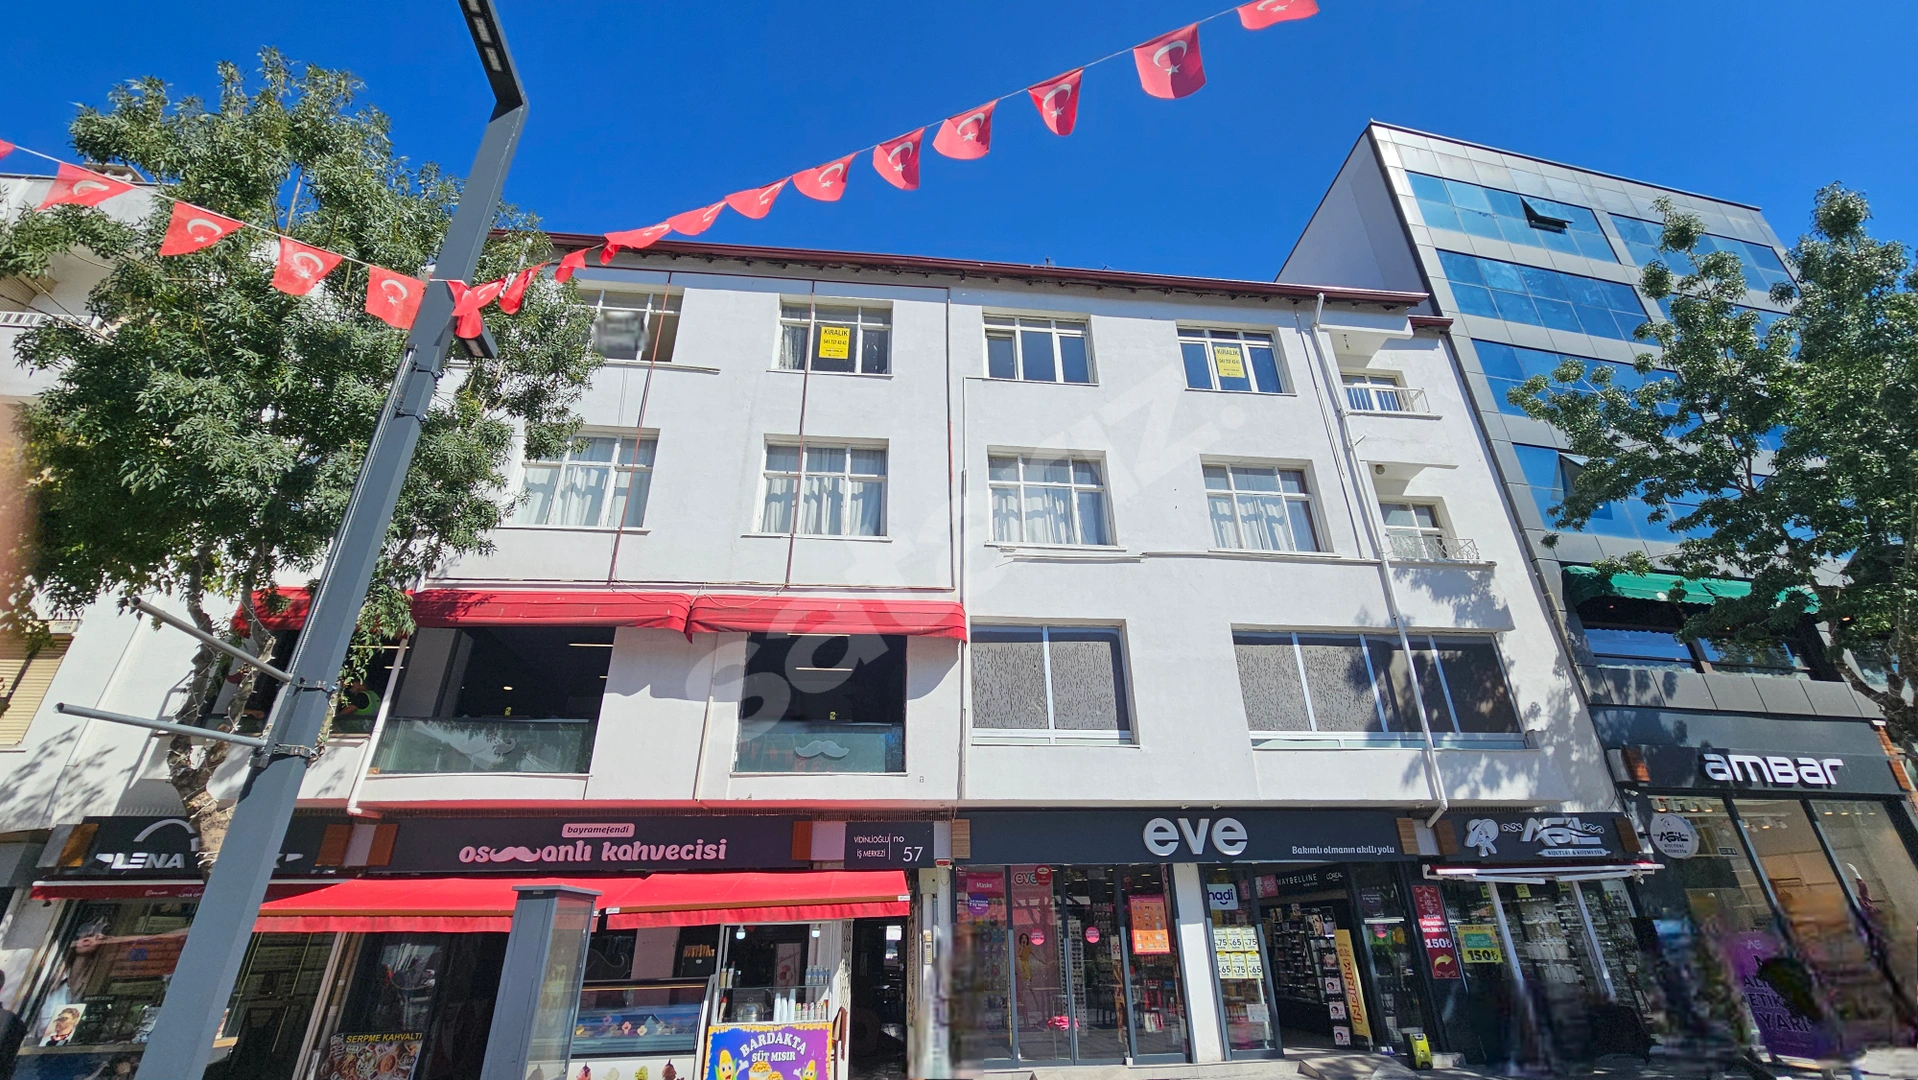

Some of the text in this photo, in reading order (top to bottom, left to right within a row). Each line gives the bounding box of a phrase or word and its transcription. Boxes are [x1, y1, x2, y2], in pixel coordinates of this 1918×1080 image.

[567, 825, 629, 835] bayramefendi
[1143, 817, 1248, 857] eve
[601, 838, 727, 861] kahvecisi
[903, 846, 923, 862] 57
[1292, 845, 1395, 856] Bakımlı olmanın akıllı yolu
[110, 852, 184, 870] LENA
[976, 881, 993, 889] Maske
[1276, 873, 1318, 886] MAYBELLINE
[346, 1032, 423, 1043] SERPME KAHVALTI
[740, 1032, 807, 1058] BARDAKTA
[752, 1049, 796, 1062] SÜT MISIR
